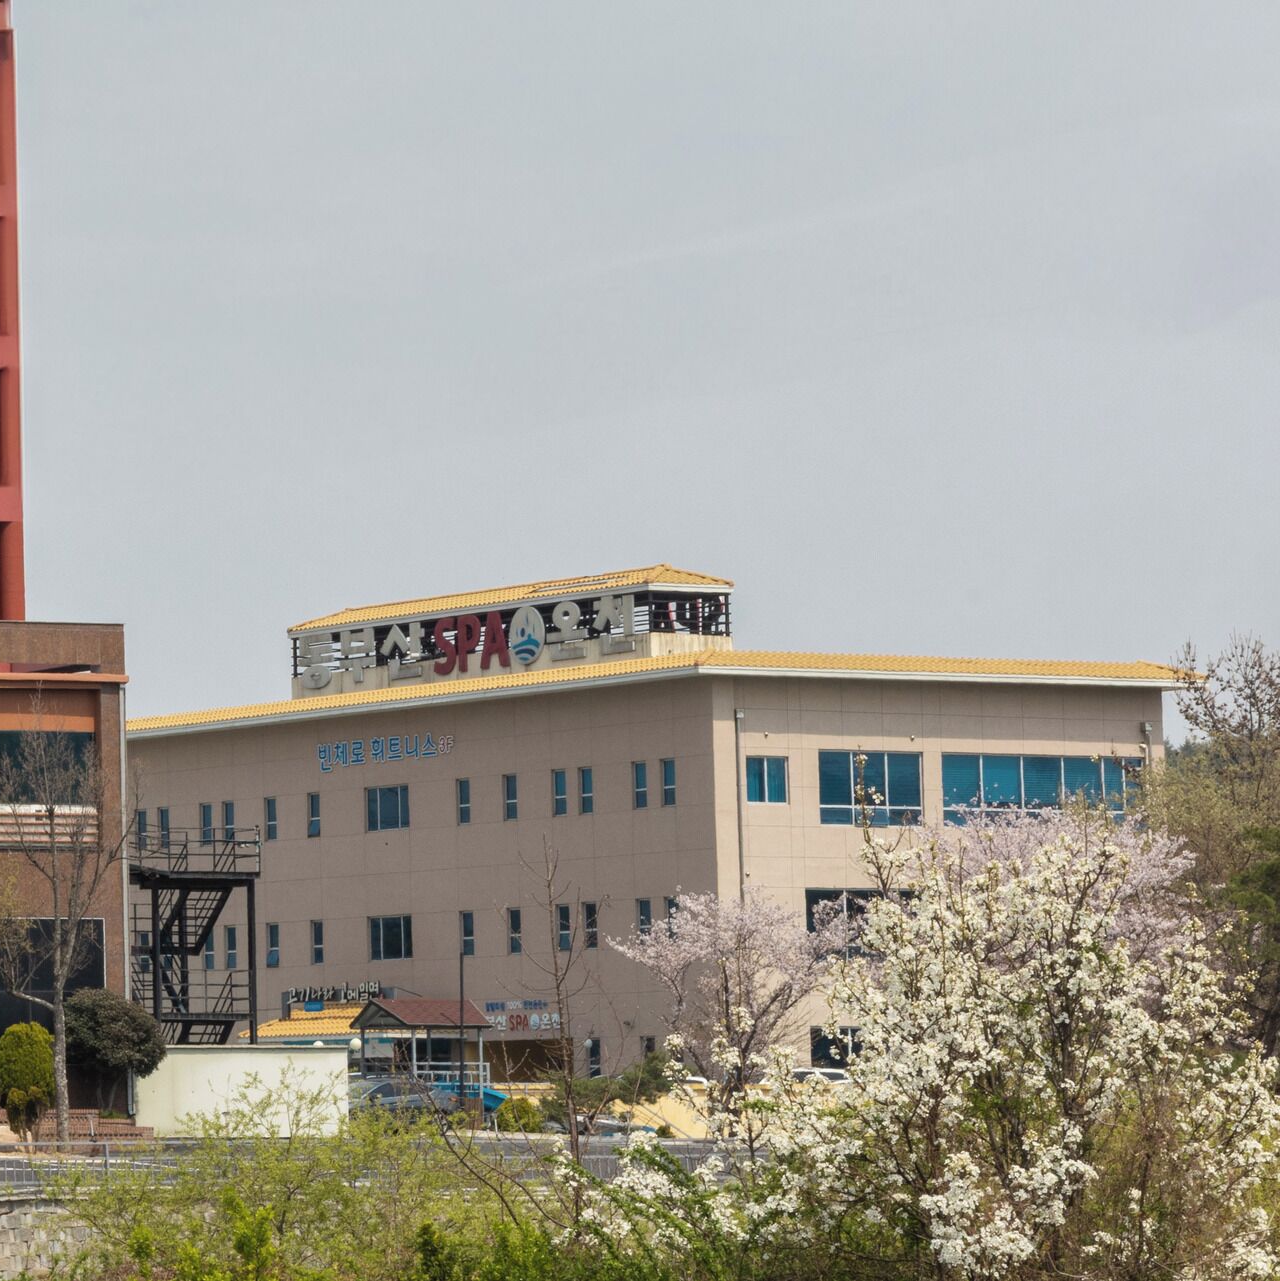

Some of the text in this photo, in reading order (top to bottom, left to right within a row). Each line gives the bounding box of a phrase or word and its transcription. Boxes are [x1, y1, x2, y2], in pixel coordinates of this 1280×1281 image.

[299, 595, 636, 689] 동부산 SPA 온천
[317, 739, 366, 773] 빈체로
[508, 1014, 530, 1032] SPA
